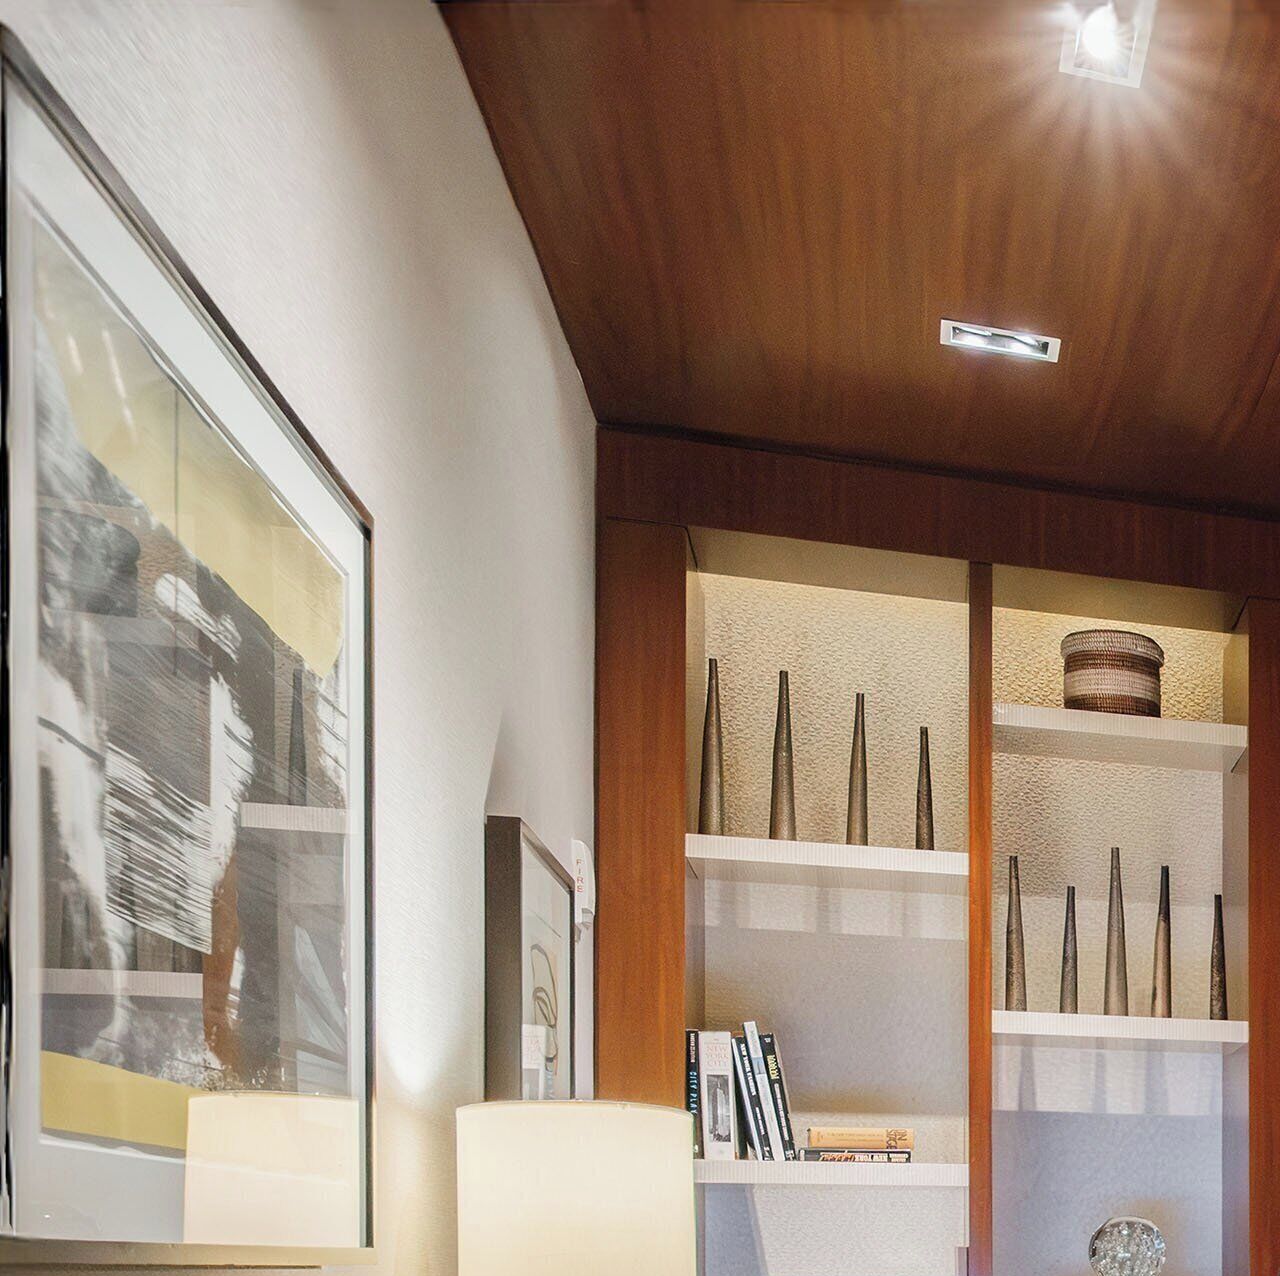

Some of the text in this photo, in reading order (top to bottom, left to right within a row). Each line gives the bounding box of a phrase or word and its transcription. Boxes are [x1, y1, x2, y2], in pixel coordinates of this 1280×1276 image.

[575, 859, 584, 893] FIRE
[706, 1044, 728, 1052] NEW
[705, 1052, 729, 1060] YORK
[707, 1060, 729, 1068] CITY
[689, 1071, 697, 1089] CITY
[690, 1093, 698, 1115] PLAY
